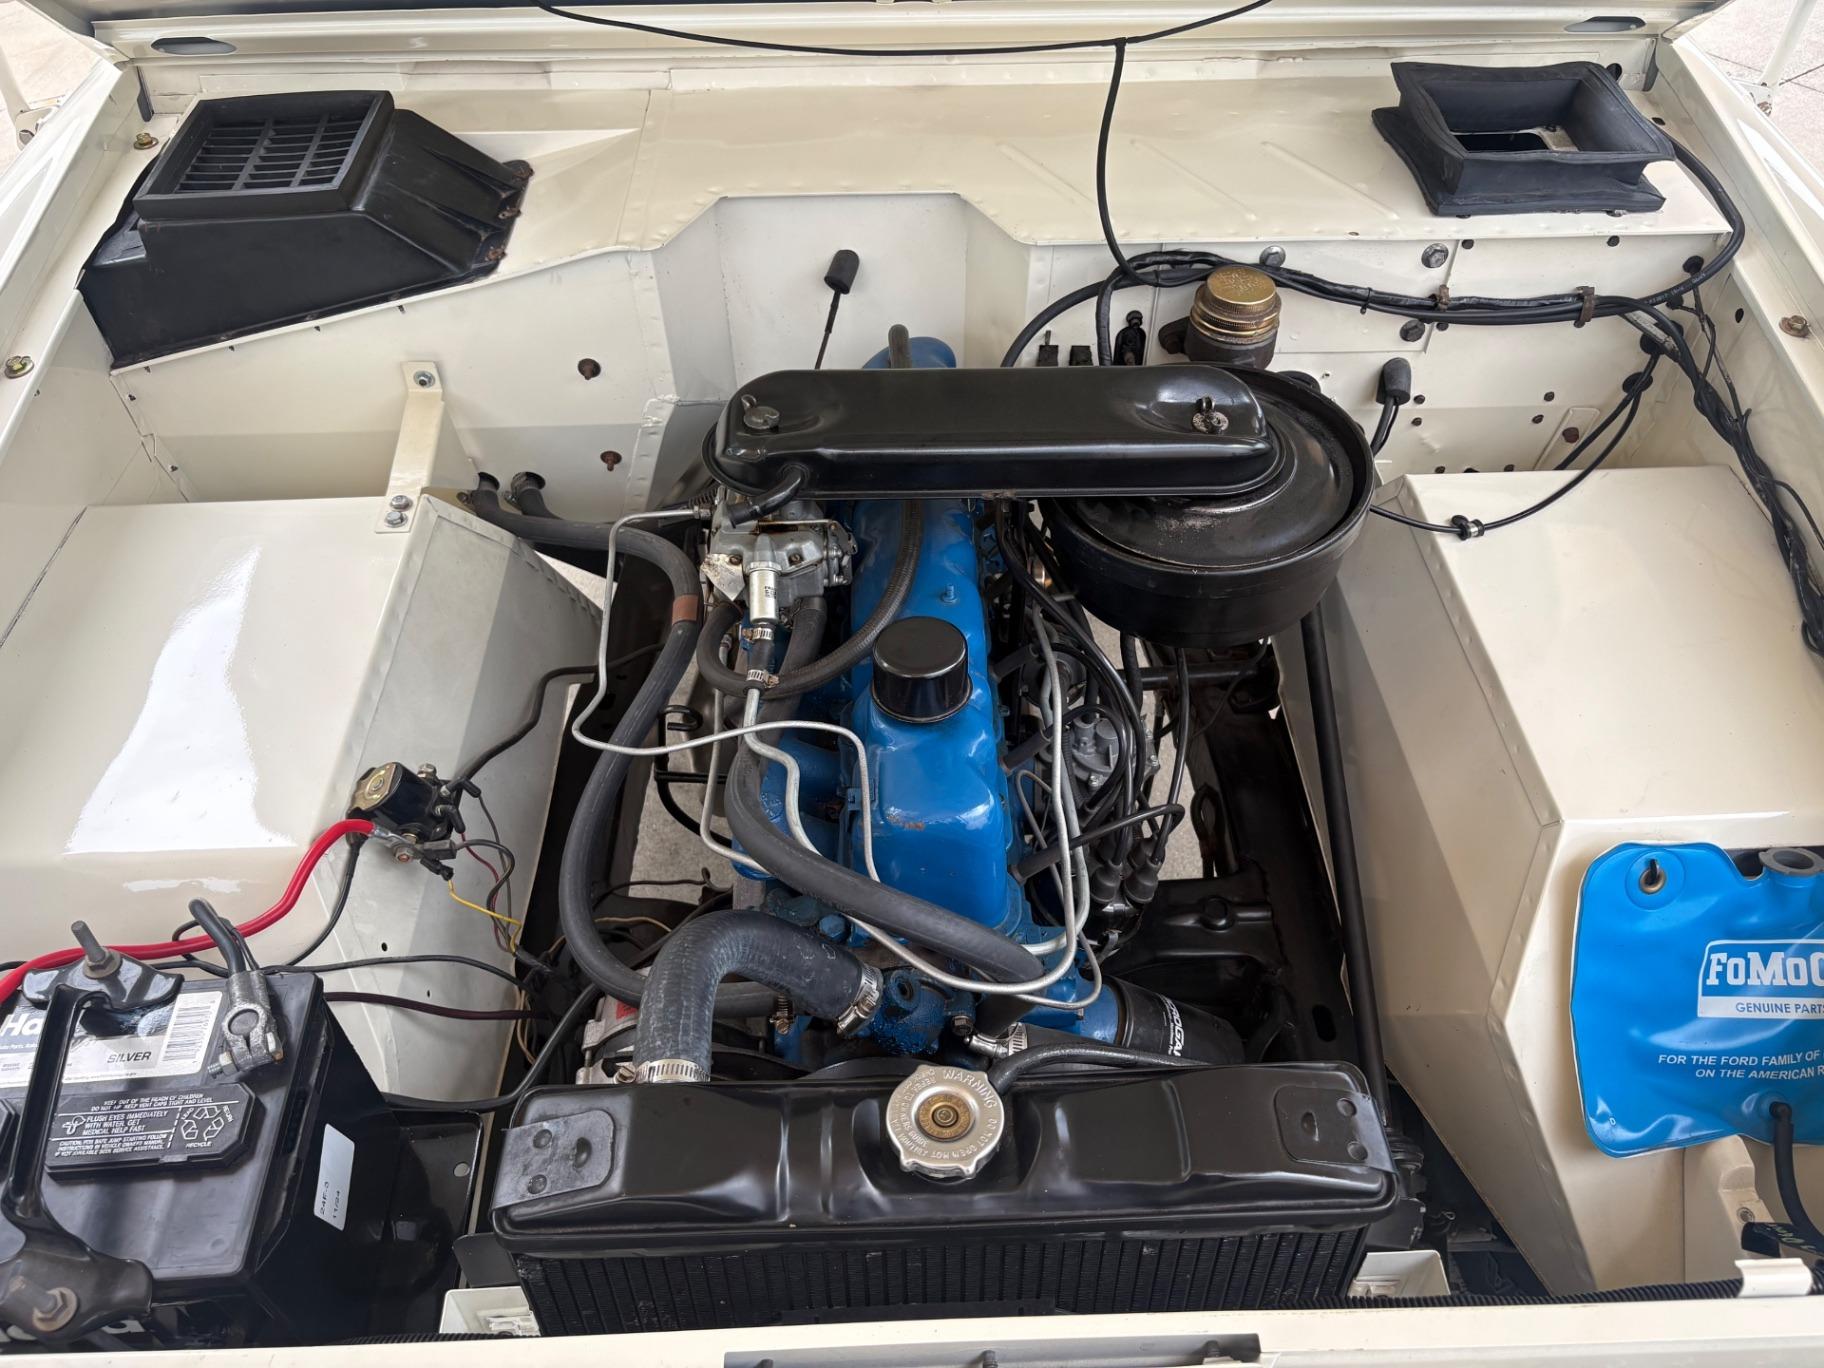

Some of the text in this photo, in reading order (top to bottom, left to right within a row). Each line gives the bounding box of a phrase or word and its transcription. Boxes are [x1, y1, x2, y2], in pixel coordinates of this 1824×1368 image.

[1735, 1002, 1791, 1013] GENUINE
[107, 1051, 152, 1063] SILVER
[1658, 1049, 1821, 1066] FOR THE FORD FAMILY OF
[1695, 1069, 1715, 1079] ON
[1719, 1069, 1746, 1079] THE
[1748, 1066, 1814, 1080] AMERICAN
[943, 1069, 997, 1108] WARNING
[108, 1113, 126, 1121] EYES
[126, 1110, 169, 1119] IMMEDIATELY
[181, 1107, 195, 1120] LEAD
[82, 1125, 146, 1136] MEDICAL HELP FAST
[85, 1121, 102, 1129] WITH
[185, 1141, 212, 1149] RECYCLE
